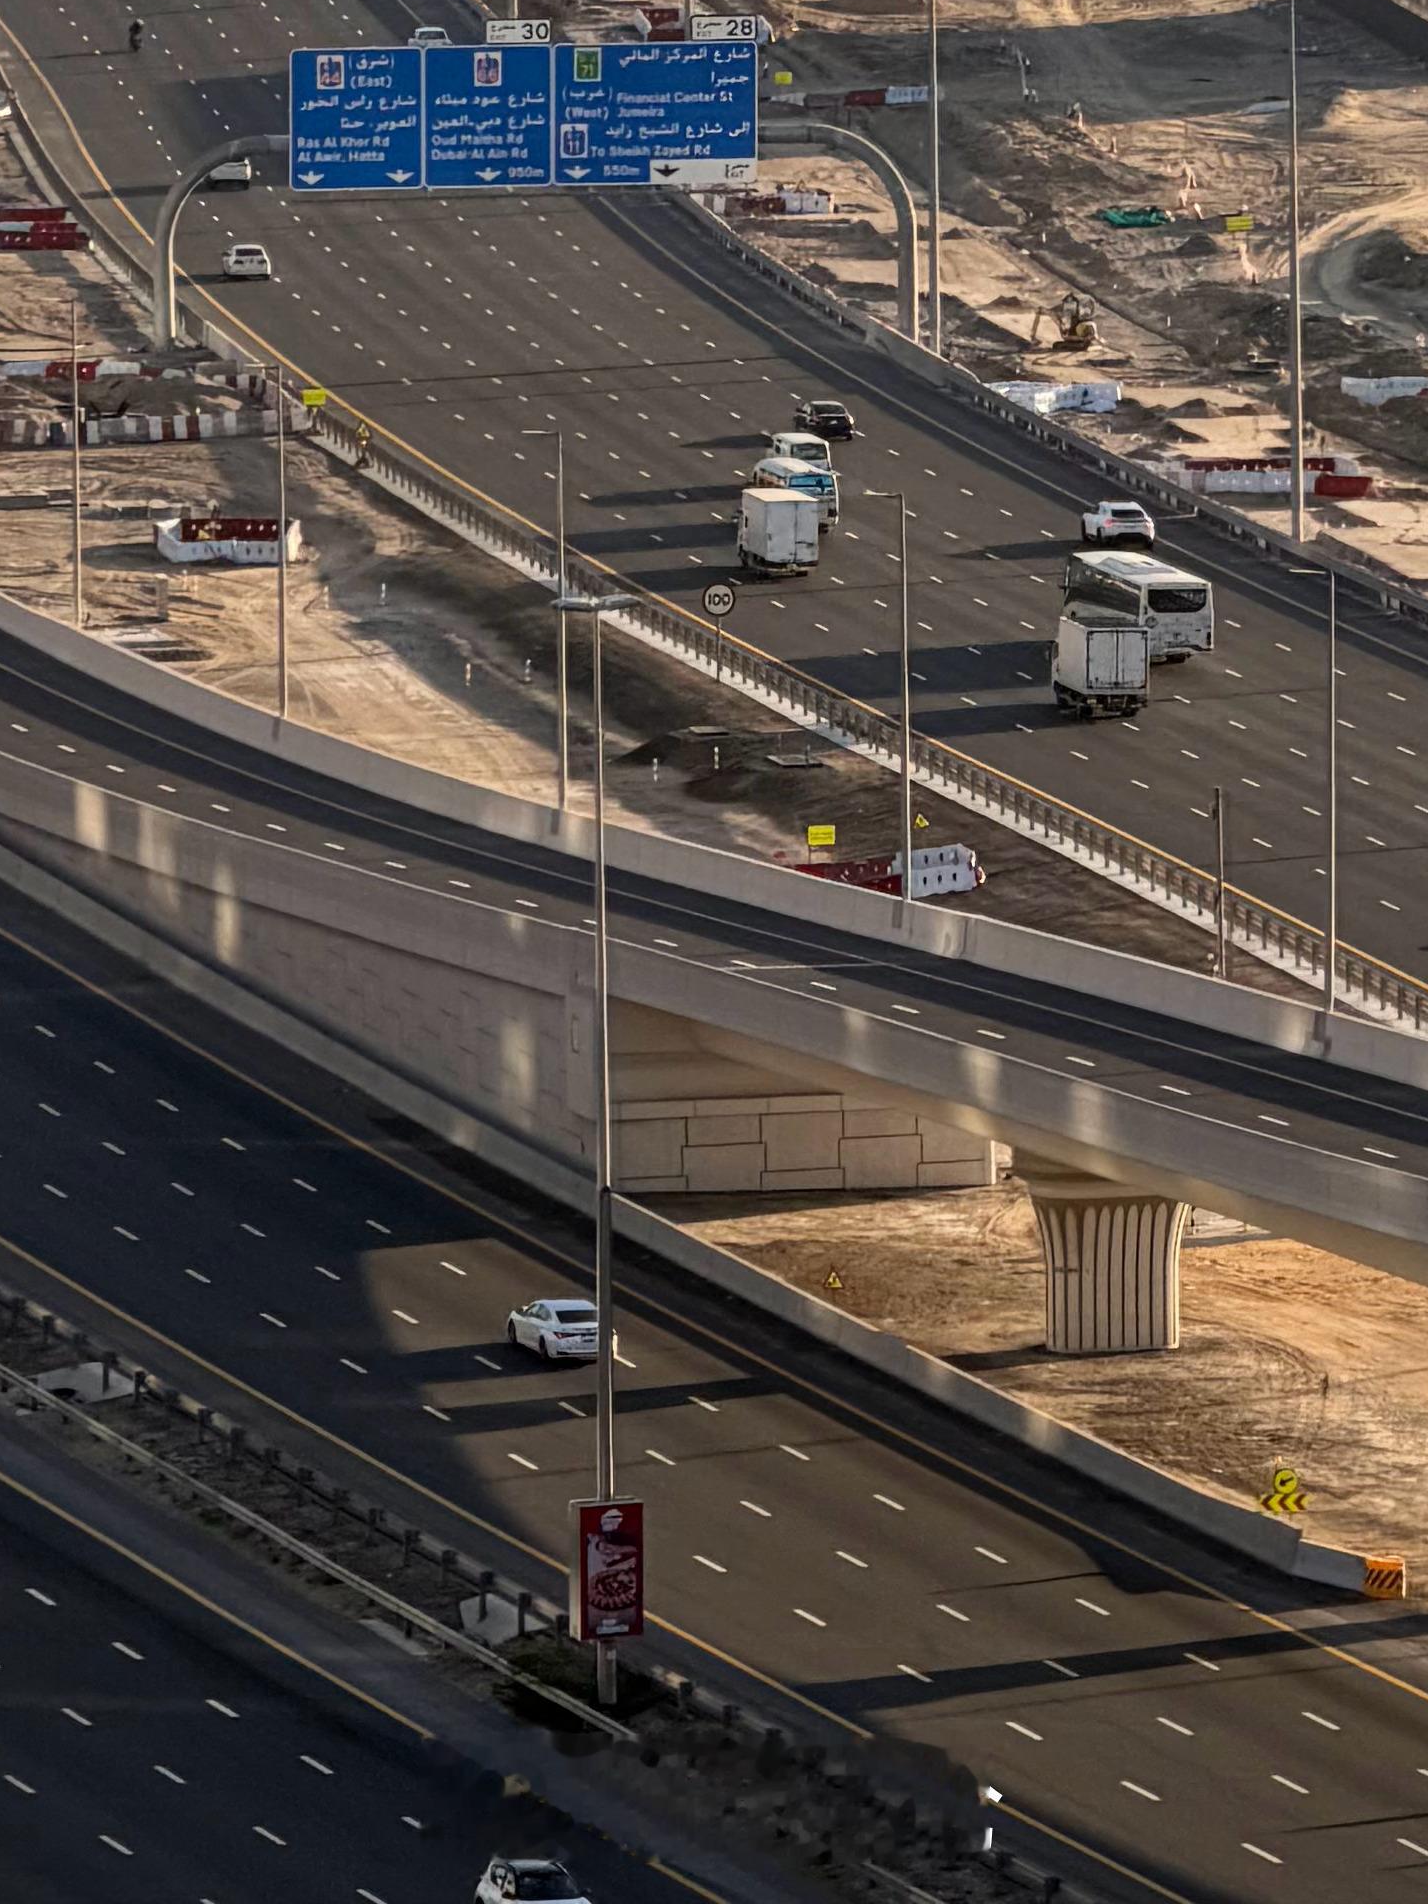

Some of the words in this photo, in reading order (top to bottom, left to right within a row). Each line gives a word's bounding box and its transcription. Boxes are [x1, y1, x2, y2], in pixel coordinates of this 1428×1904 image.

[522, 22, 549, 40] 30
[727, 19, 753, 36] 28
[663, 47, 708, 65] المركز
[713, 48, 751, 64] شارع
[711, 71, 749, 88] جميرا
[379, 94, 418, 111] شارع
[508, 92, 546, 108] شارع
[508, 113, 546, 130] شارع
[685, 122, 723, 139] شارع
[590, 145, 606, 157] To
[694, 143, 711, 156] Rd
[707, 593, 731, 606] 100
